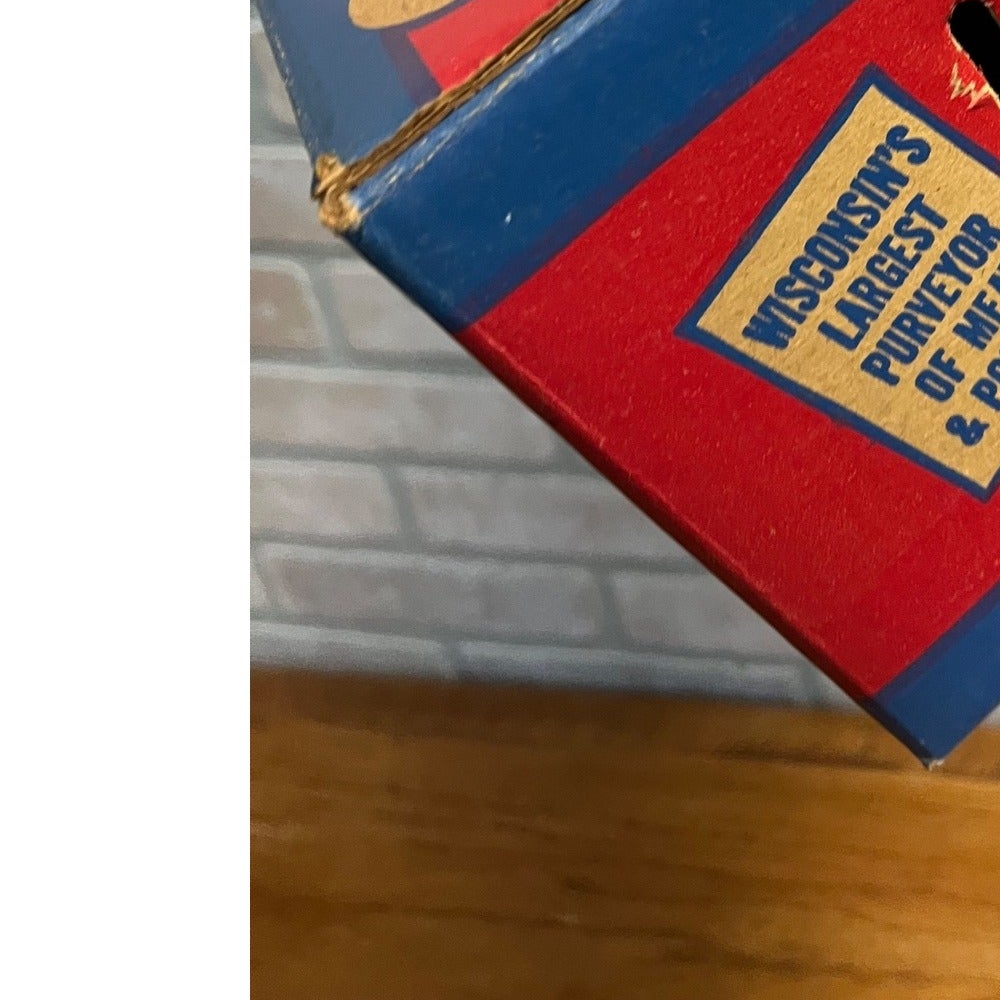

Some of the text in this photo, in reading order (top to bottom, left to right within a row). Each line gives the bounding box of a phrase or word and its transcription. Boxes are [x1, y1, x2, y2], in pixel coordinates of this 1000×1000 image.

[742, 124, 932, 350] WISCONSIN'S
[818, 193, 948, 351] LARGEST
[914, 348, 966, 403] OF
[945, 413, 990, 447] &
